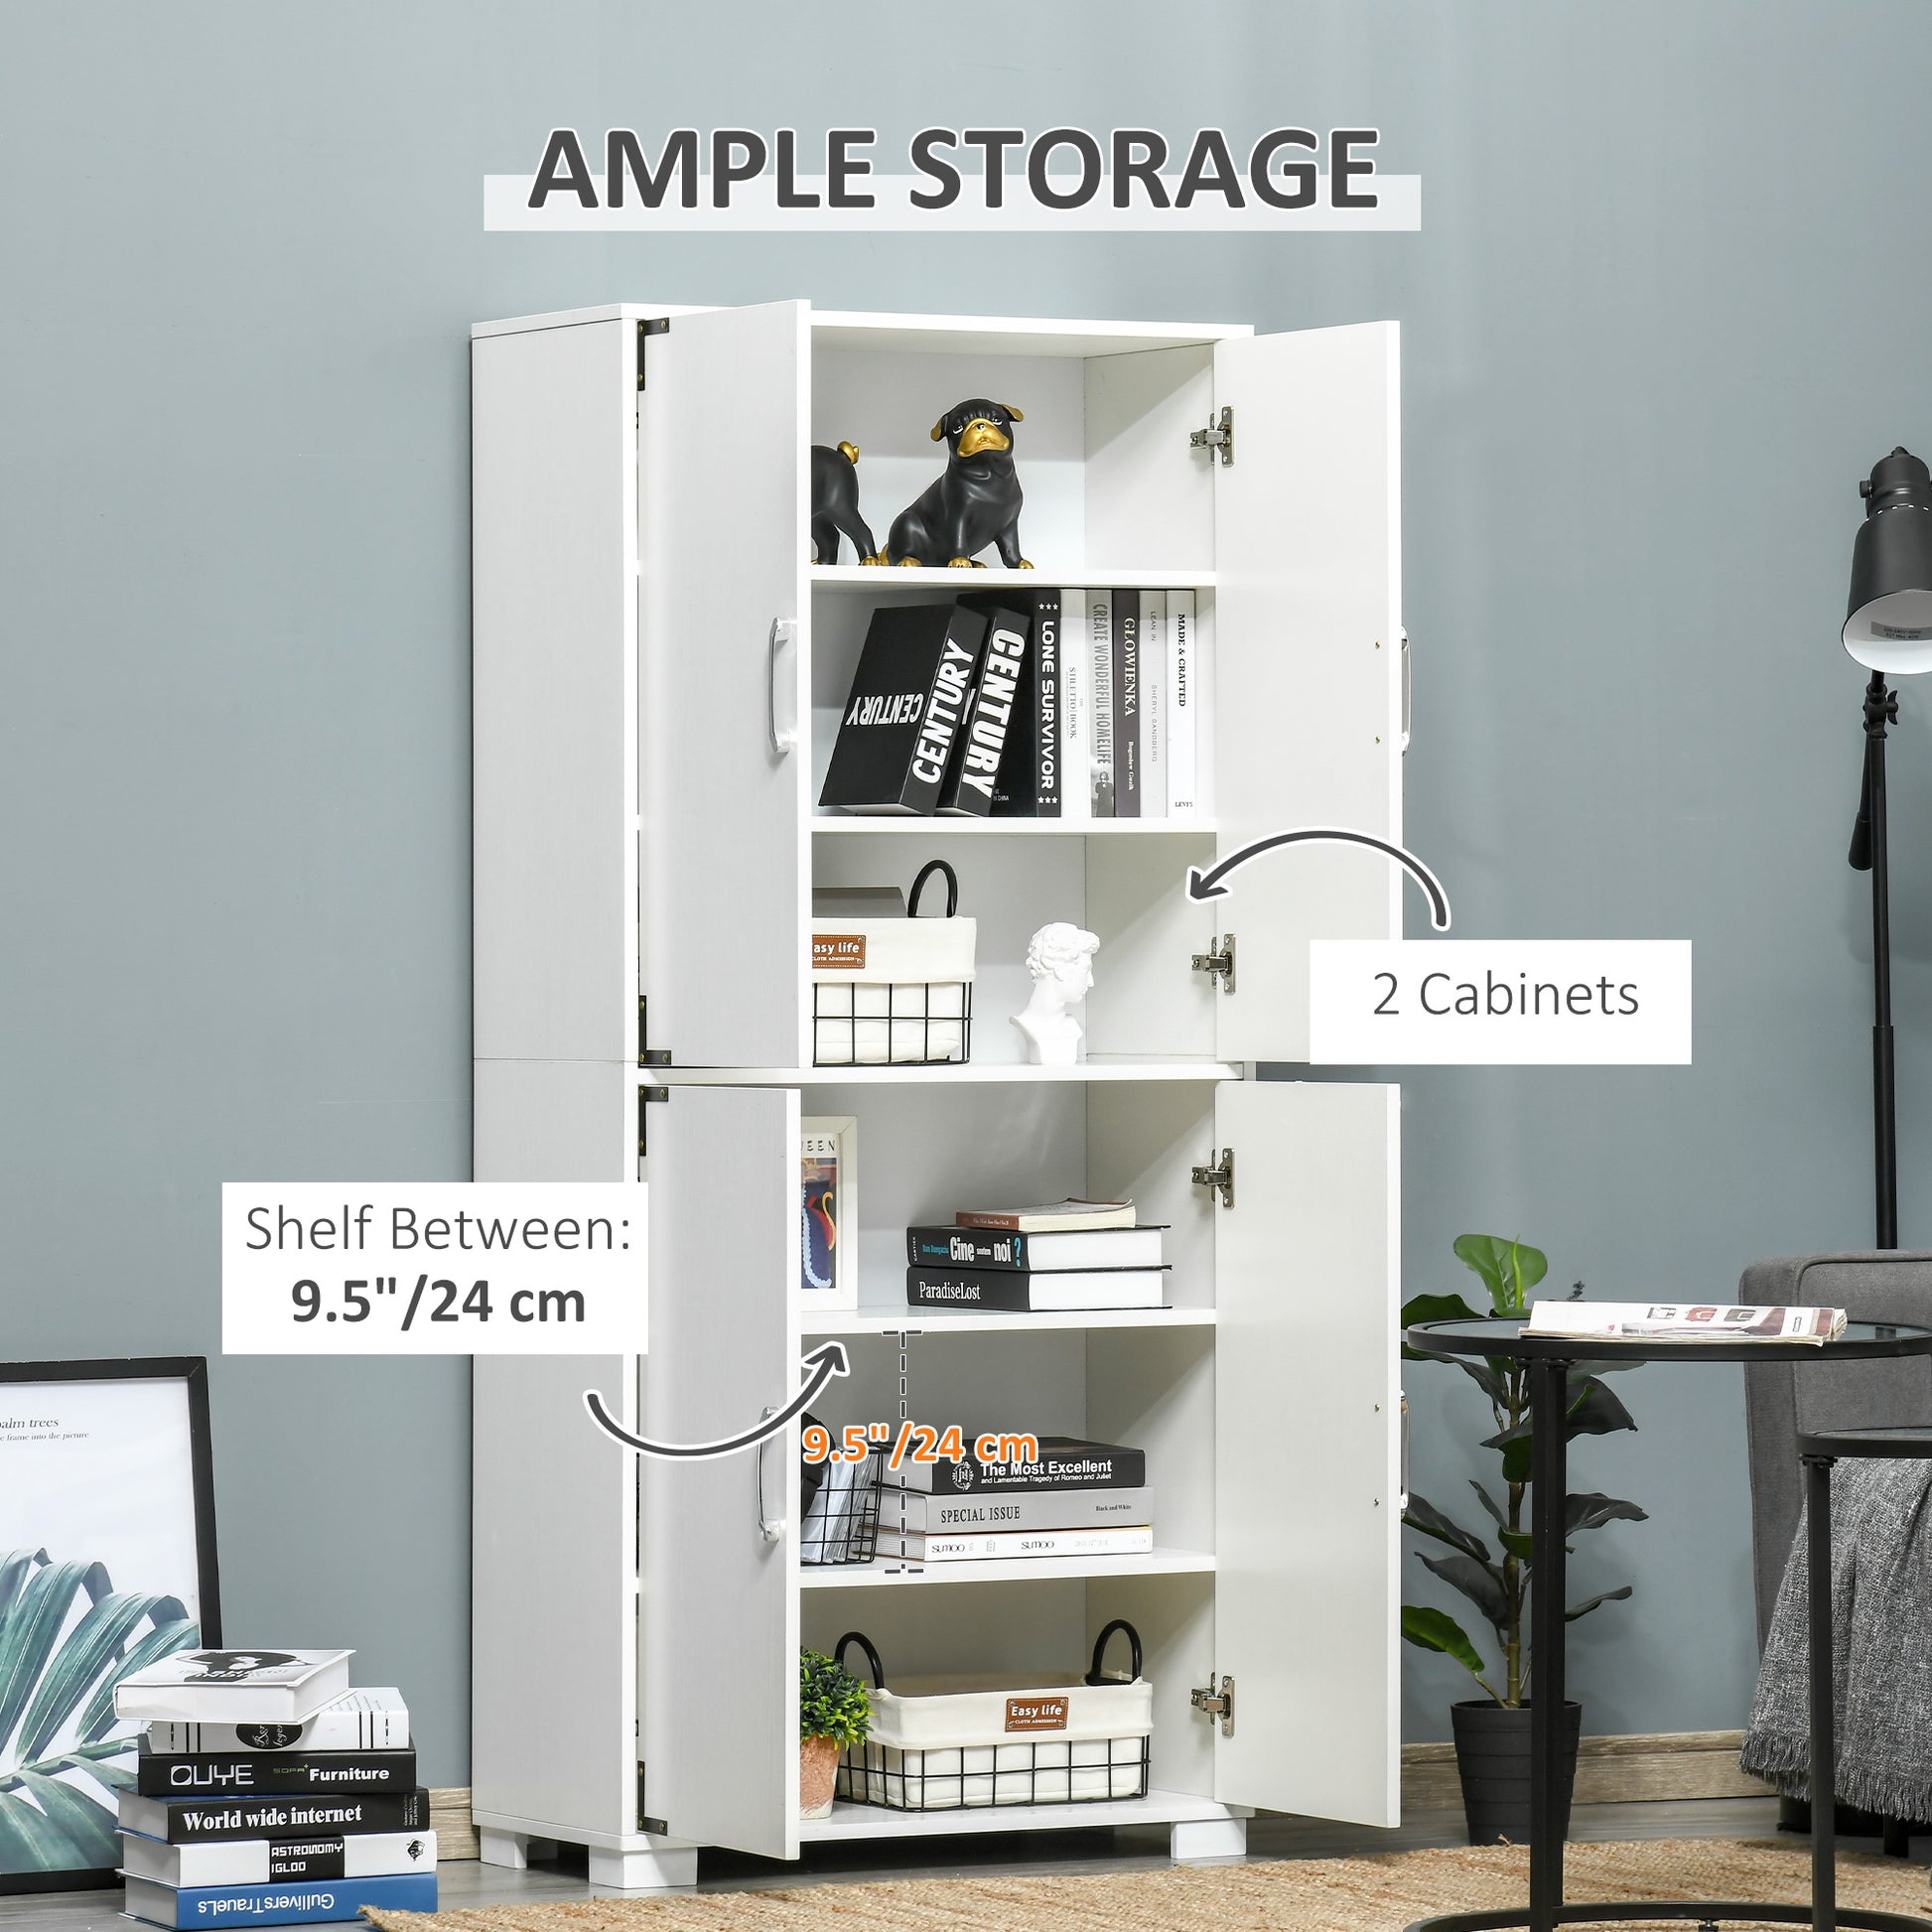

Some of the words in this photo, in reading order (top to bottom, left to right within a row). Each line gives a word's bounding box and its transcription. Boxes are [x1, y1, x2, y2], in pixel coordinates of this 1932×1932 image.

[1093, 604, 1109, 641] CREATE
[1041, 621, 1055, 673] LONE
[1177, 647, 1185, 656] &
[1094, 644, 1111, 709] WONDERFUL
[1178, 658, 1187, 707] CRAFTED
[846, 692, 924, 726] CENTURY
[912, 637, 975, 784] CENTURY
[962, 627, 1026, 798] CENTURY
[1041, 679, 1055, 789] SURVIVOR
[1096, 713, 1112, 764] HOMELIFE
[813, 944, 835, 954] asy
[838, 942, 860, 953] life
[800, 1140, 836, 1152] EEN
[949, 1236, 974, 1262] Cine
[0, 1417, 25, 1429] alm
[29, 1419, 60, 1428] trees
[62, 1432, 89, 1441] picture
[980, 1461, 1007, 1477] The
[1011, 1460, 1045, 1476] Most
[1048, 1458, 1113, 1474] Excellent
[994, 1474, 1028, 1484] Lamentable
[1029, 1474, 1053, 1484] Tragedy
[940, 1507, 986, 1524] SPECIAL
[989, 1505, 1021, 1521] ISSUE
[1012, 1706, 1038, 1718] Easy
[1040, 1704, 1062, 1716] life
[170, 1764, 255, 1786] OUYE
[309, 1767, 390, 1782] Furniture
[182, 1809, 242, 1832] World
[245, 1807, 288, 1829] wide
[291, 1803, 362, 1826] internet
[271, 1842, 344, 1858] ASTRONOMY
[271, 1861, 307, 1874] IGLOO
